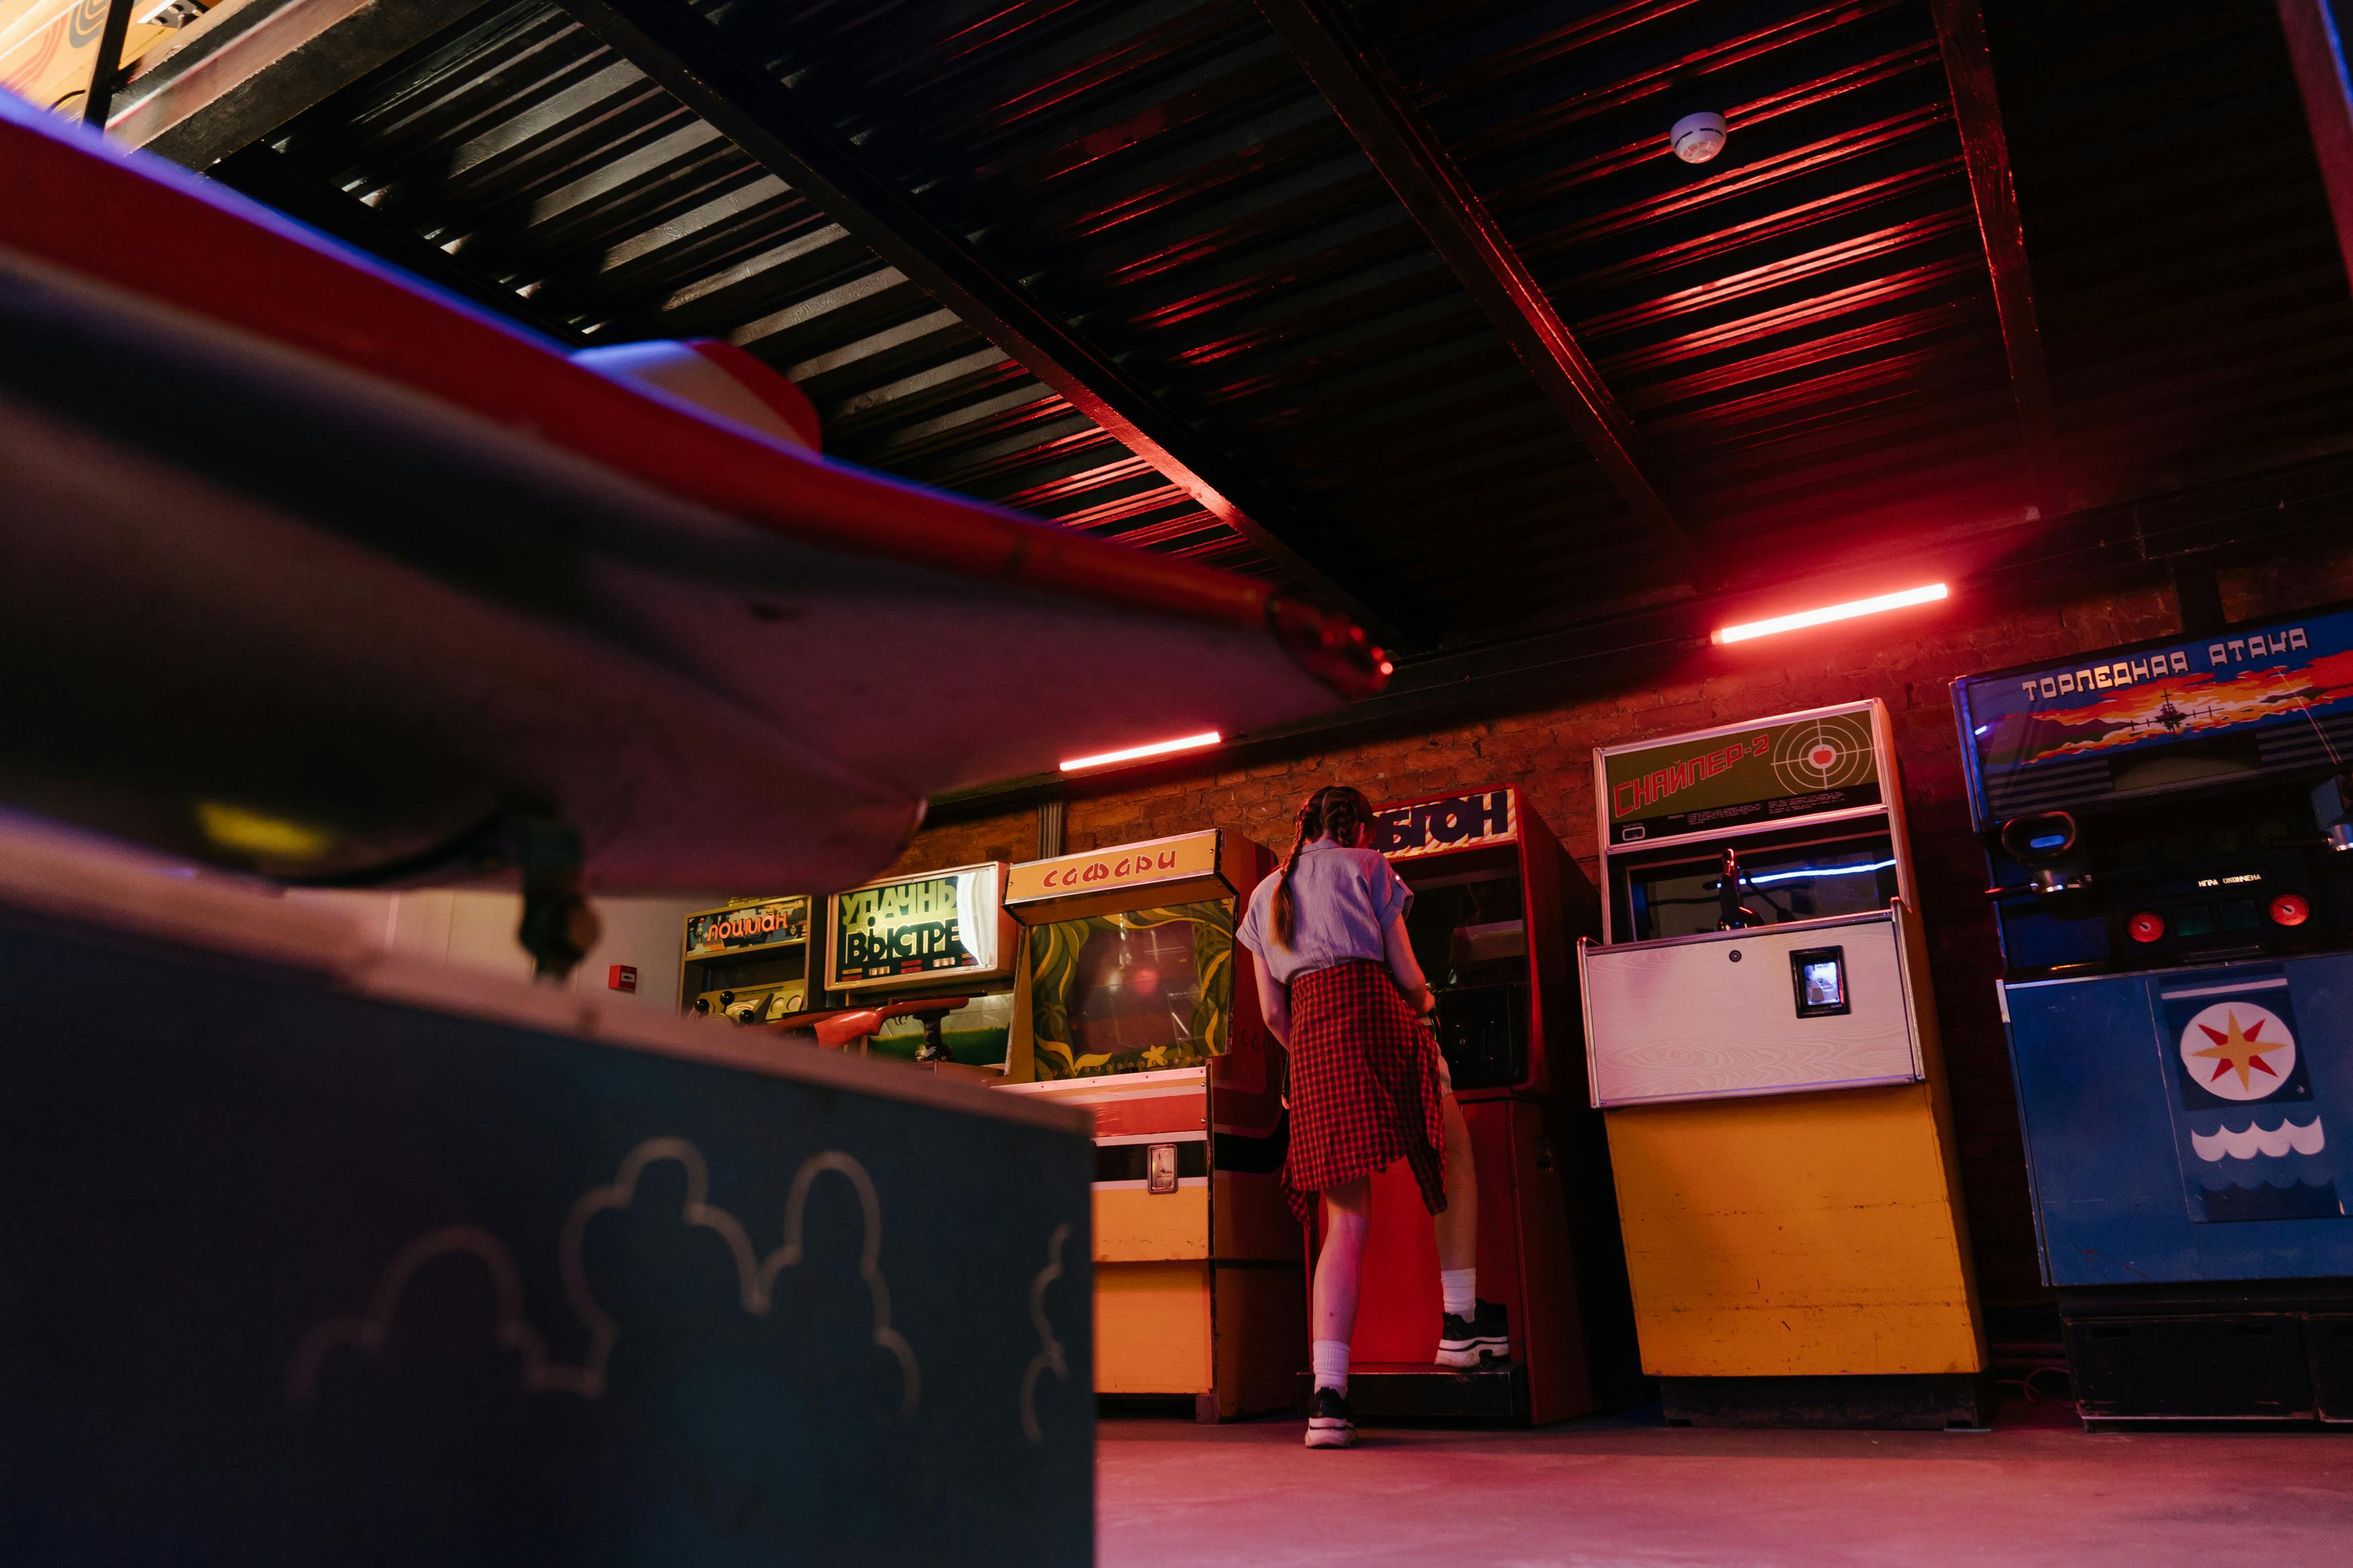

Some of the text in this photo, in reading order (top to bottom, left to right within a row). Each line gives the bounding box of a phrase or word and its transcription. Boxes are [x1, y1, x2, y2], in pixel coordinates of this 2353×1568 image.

[2021, 627, 2309, 702] ТОРПЕДНАЯ АТАКА
[1613, 733, 1770, 818] СНАЙПЕР-2
[2197, 873, 2262, 888] ИГРА ОКОНЧЕНА
[846, 919, 961, 963] ВЫСТРЕ
